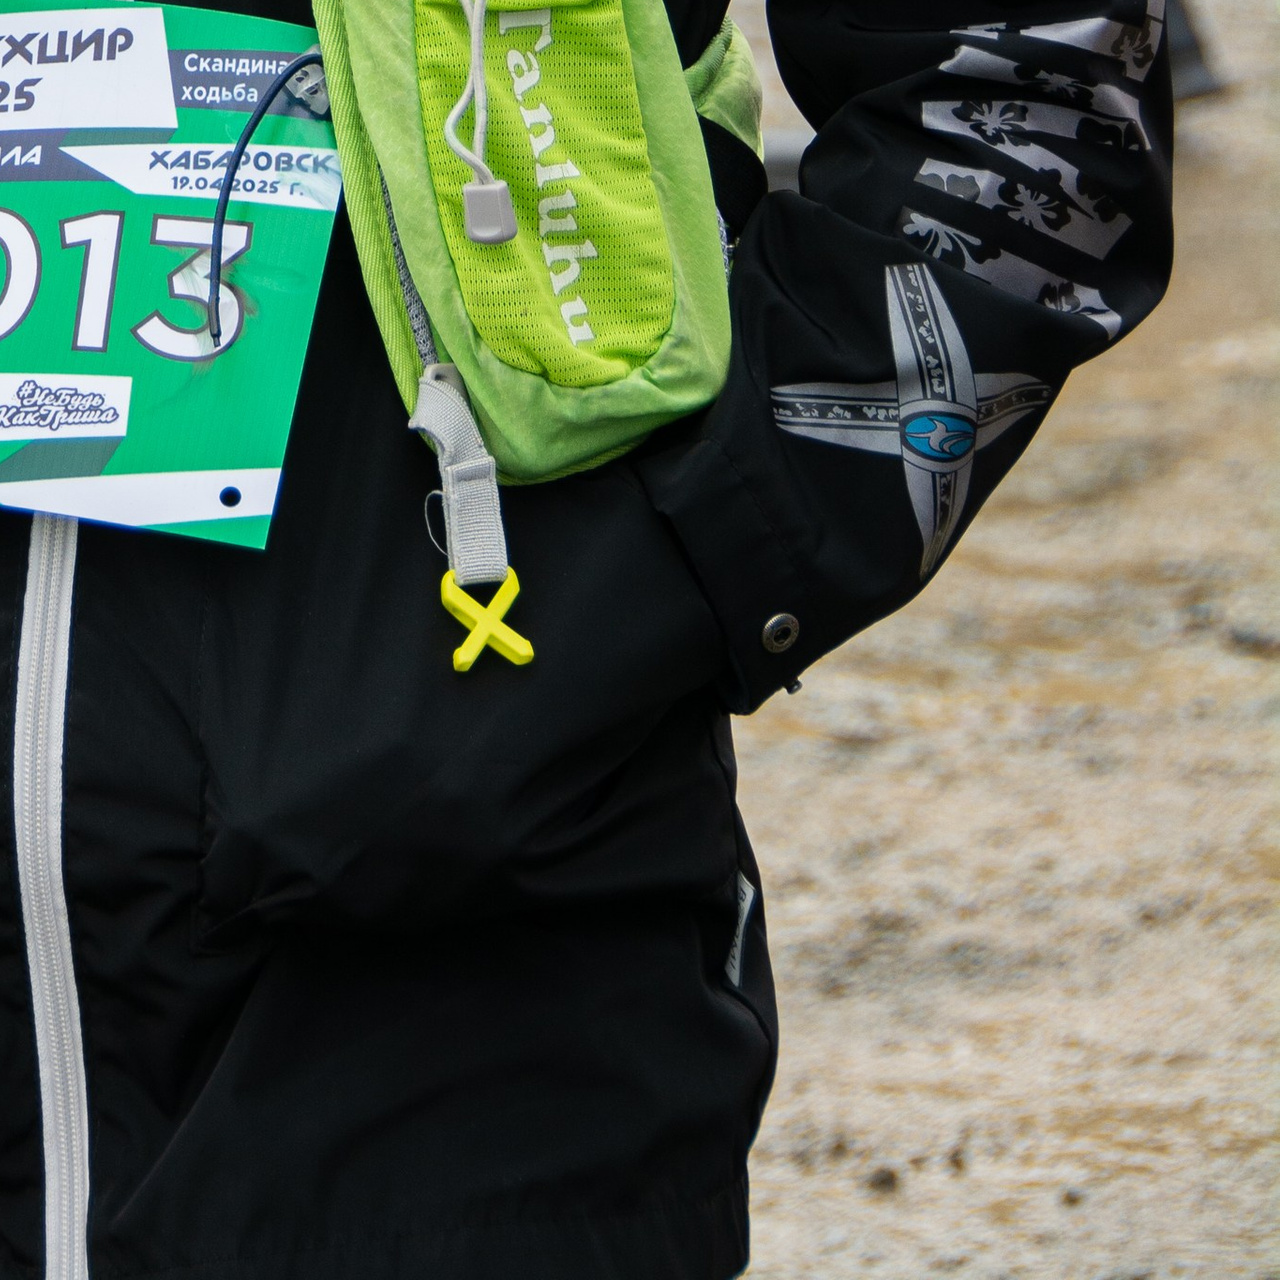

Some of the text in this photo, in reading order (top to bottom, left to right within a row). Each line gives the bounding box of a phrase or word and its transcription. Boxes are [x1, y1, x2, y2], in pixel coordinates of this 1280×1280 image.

[184, 53, 288, 76] Скандина
[181, 83, 259, 103] ходьба
[149, 149, 340, 174] ХАБАРОВСК
[171, 176, 281, 195] 19.042025
